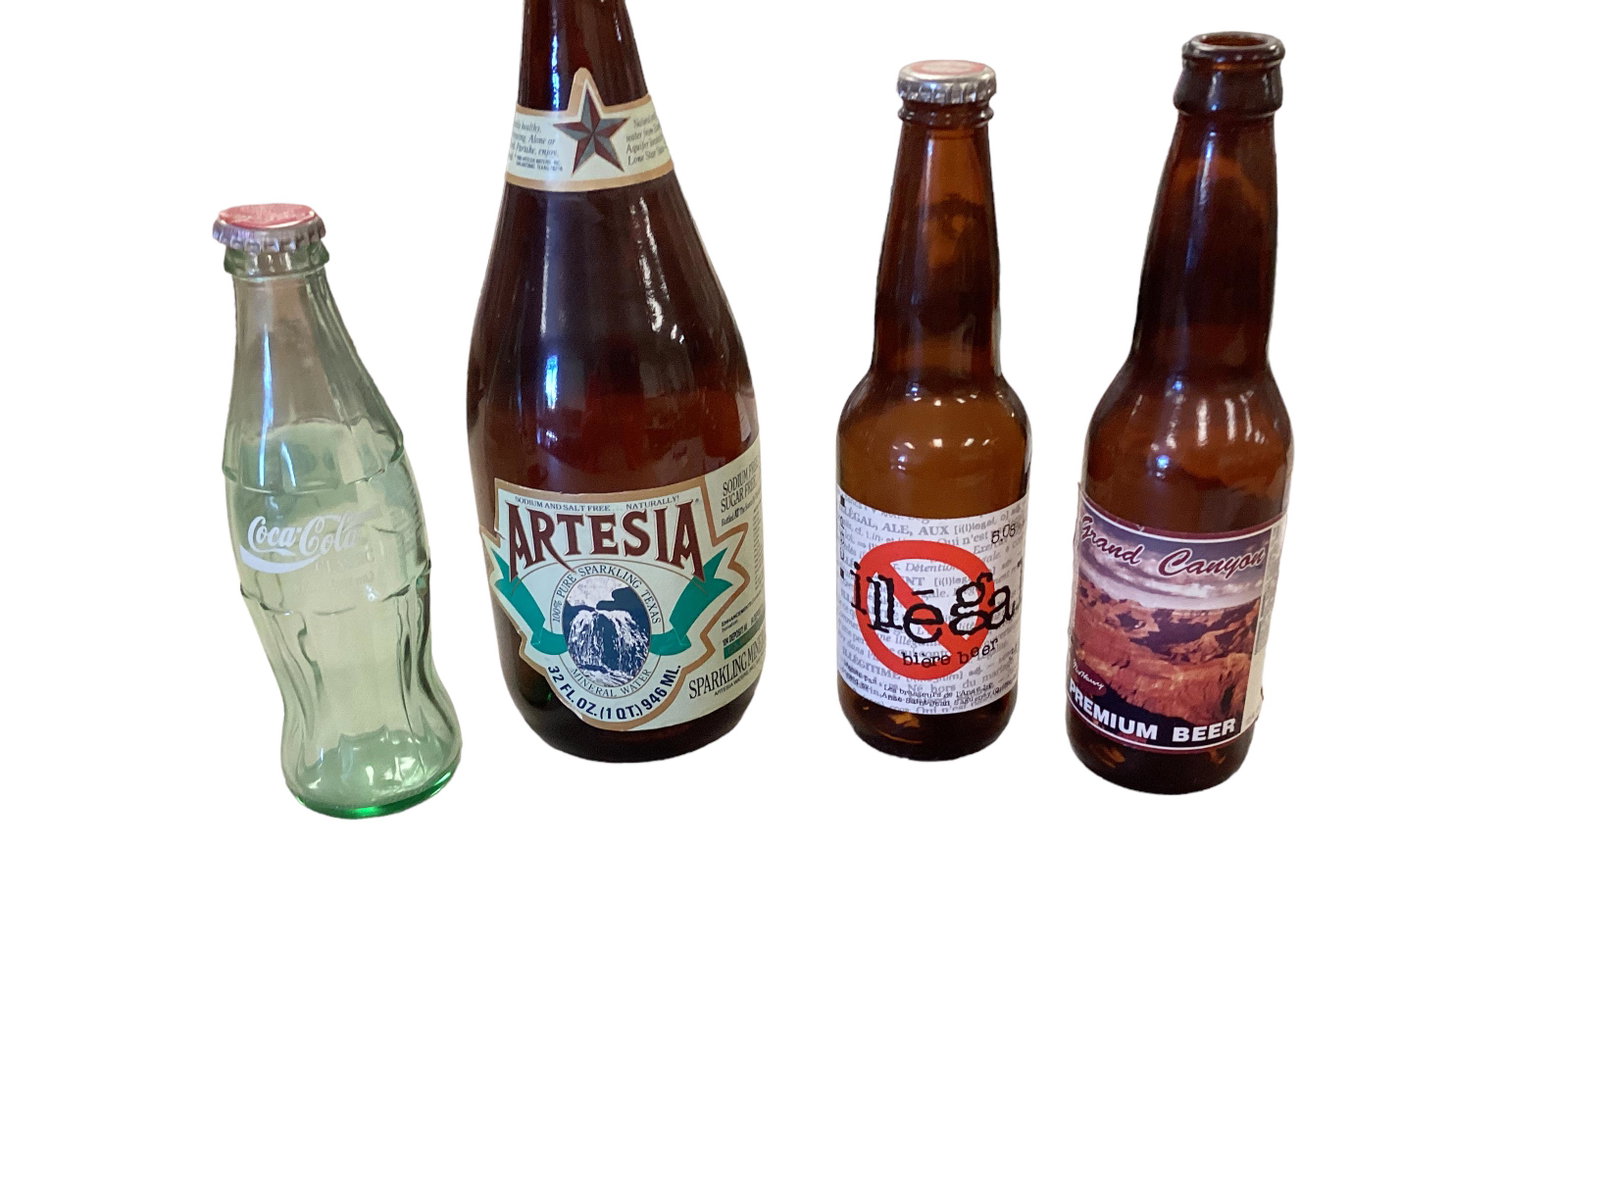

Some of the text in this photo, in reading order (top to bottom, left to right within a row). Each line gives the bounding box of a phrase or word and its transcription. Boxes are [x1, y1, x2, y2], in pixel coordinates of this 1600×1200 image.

[545, 501, 562, 510] AND
[563, 503, 586, 512] SALT
[587, 504, 611, 512] FREE
[882, 522, 913, 536] ALE,
[918, 525, 950, 536] AUX
[505, 499, 705, 583] ARTESIA
[1081, 514, 1266, 580] Grand Canyon
[557, 573, 577, 597] PURE
[577, 564, 643, 589] SPARKLING
[641, 589, 662, 625] TEXAS
[688, 650, 747, 700] SPARKLING
[901, 650, 951, 668] bière
[957, 638, 998, 665] beer
[548, 664, 681, 721] 32 FL. OZ. (1 QT.) 946 ML.
[570, 667, 651, 698] MINERAL WATER
[1069, 677, 1236, 742] PREMIUM BEER
